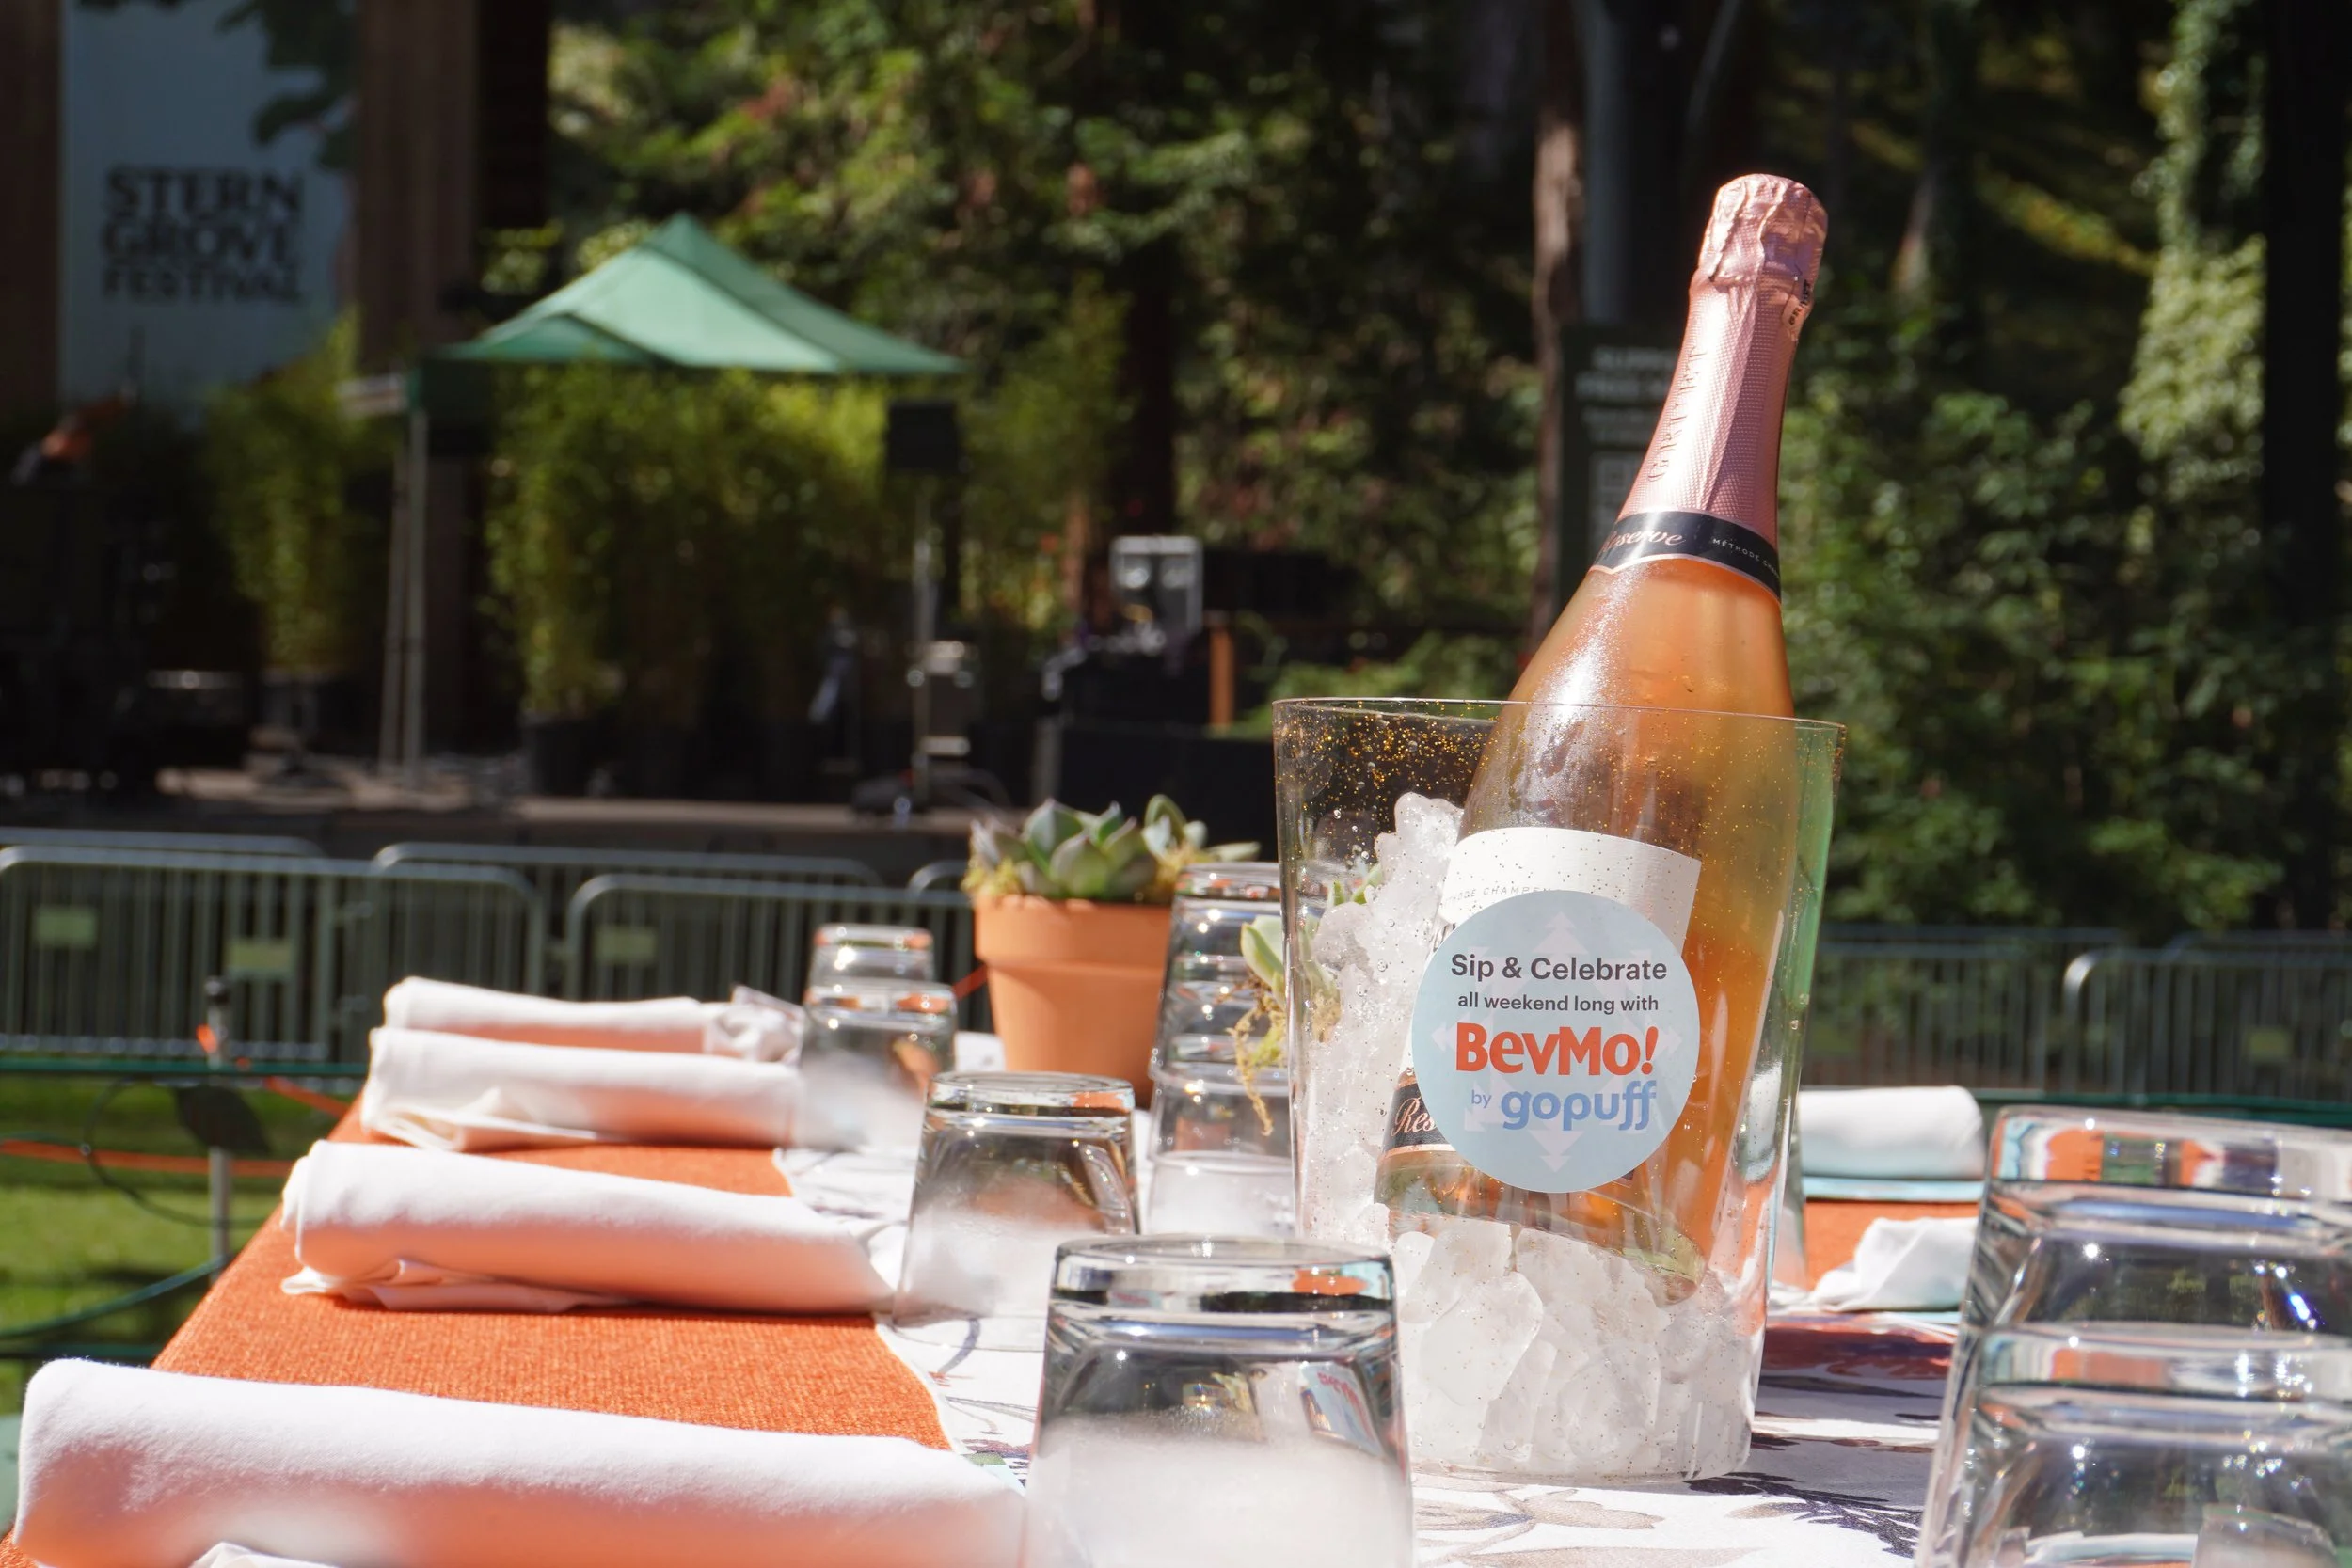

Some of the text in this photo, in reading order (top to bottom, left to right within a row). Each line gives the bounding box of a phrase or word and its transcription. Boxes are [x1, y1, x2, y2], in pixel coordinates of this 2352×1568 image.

[106, 165, 304, 220] STERN
[100, 219, 301, 265] GROVE
[102, 264, 305, 304] FESTIVAL
[1451, 953, 1667, 982] Sip & Celebrate
[1457, 991, 1659, 1016] all weekend long with
[1455, 1022, 1660, 1077] BevMo!
[1470, 1079, 1658, 1132] by gopuff
